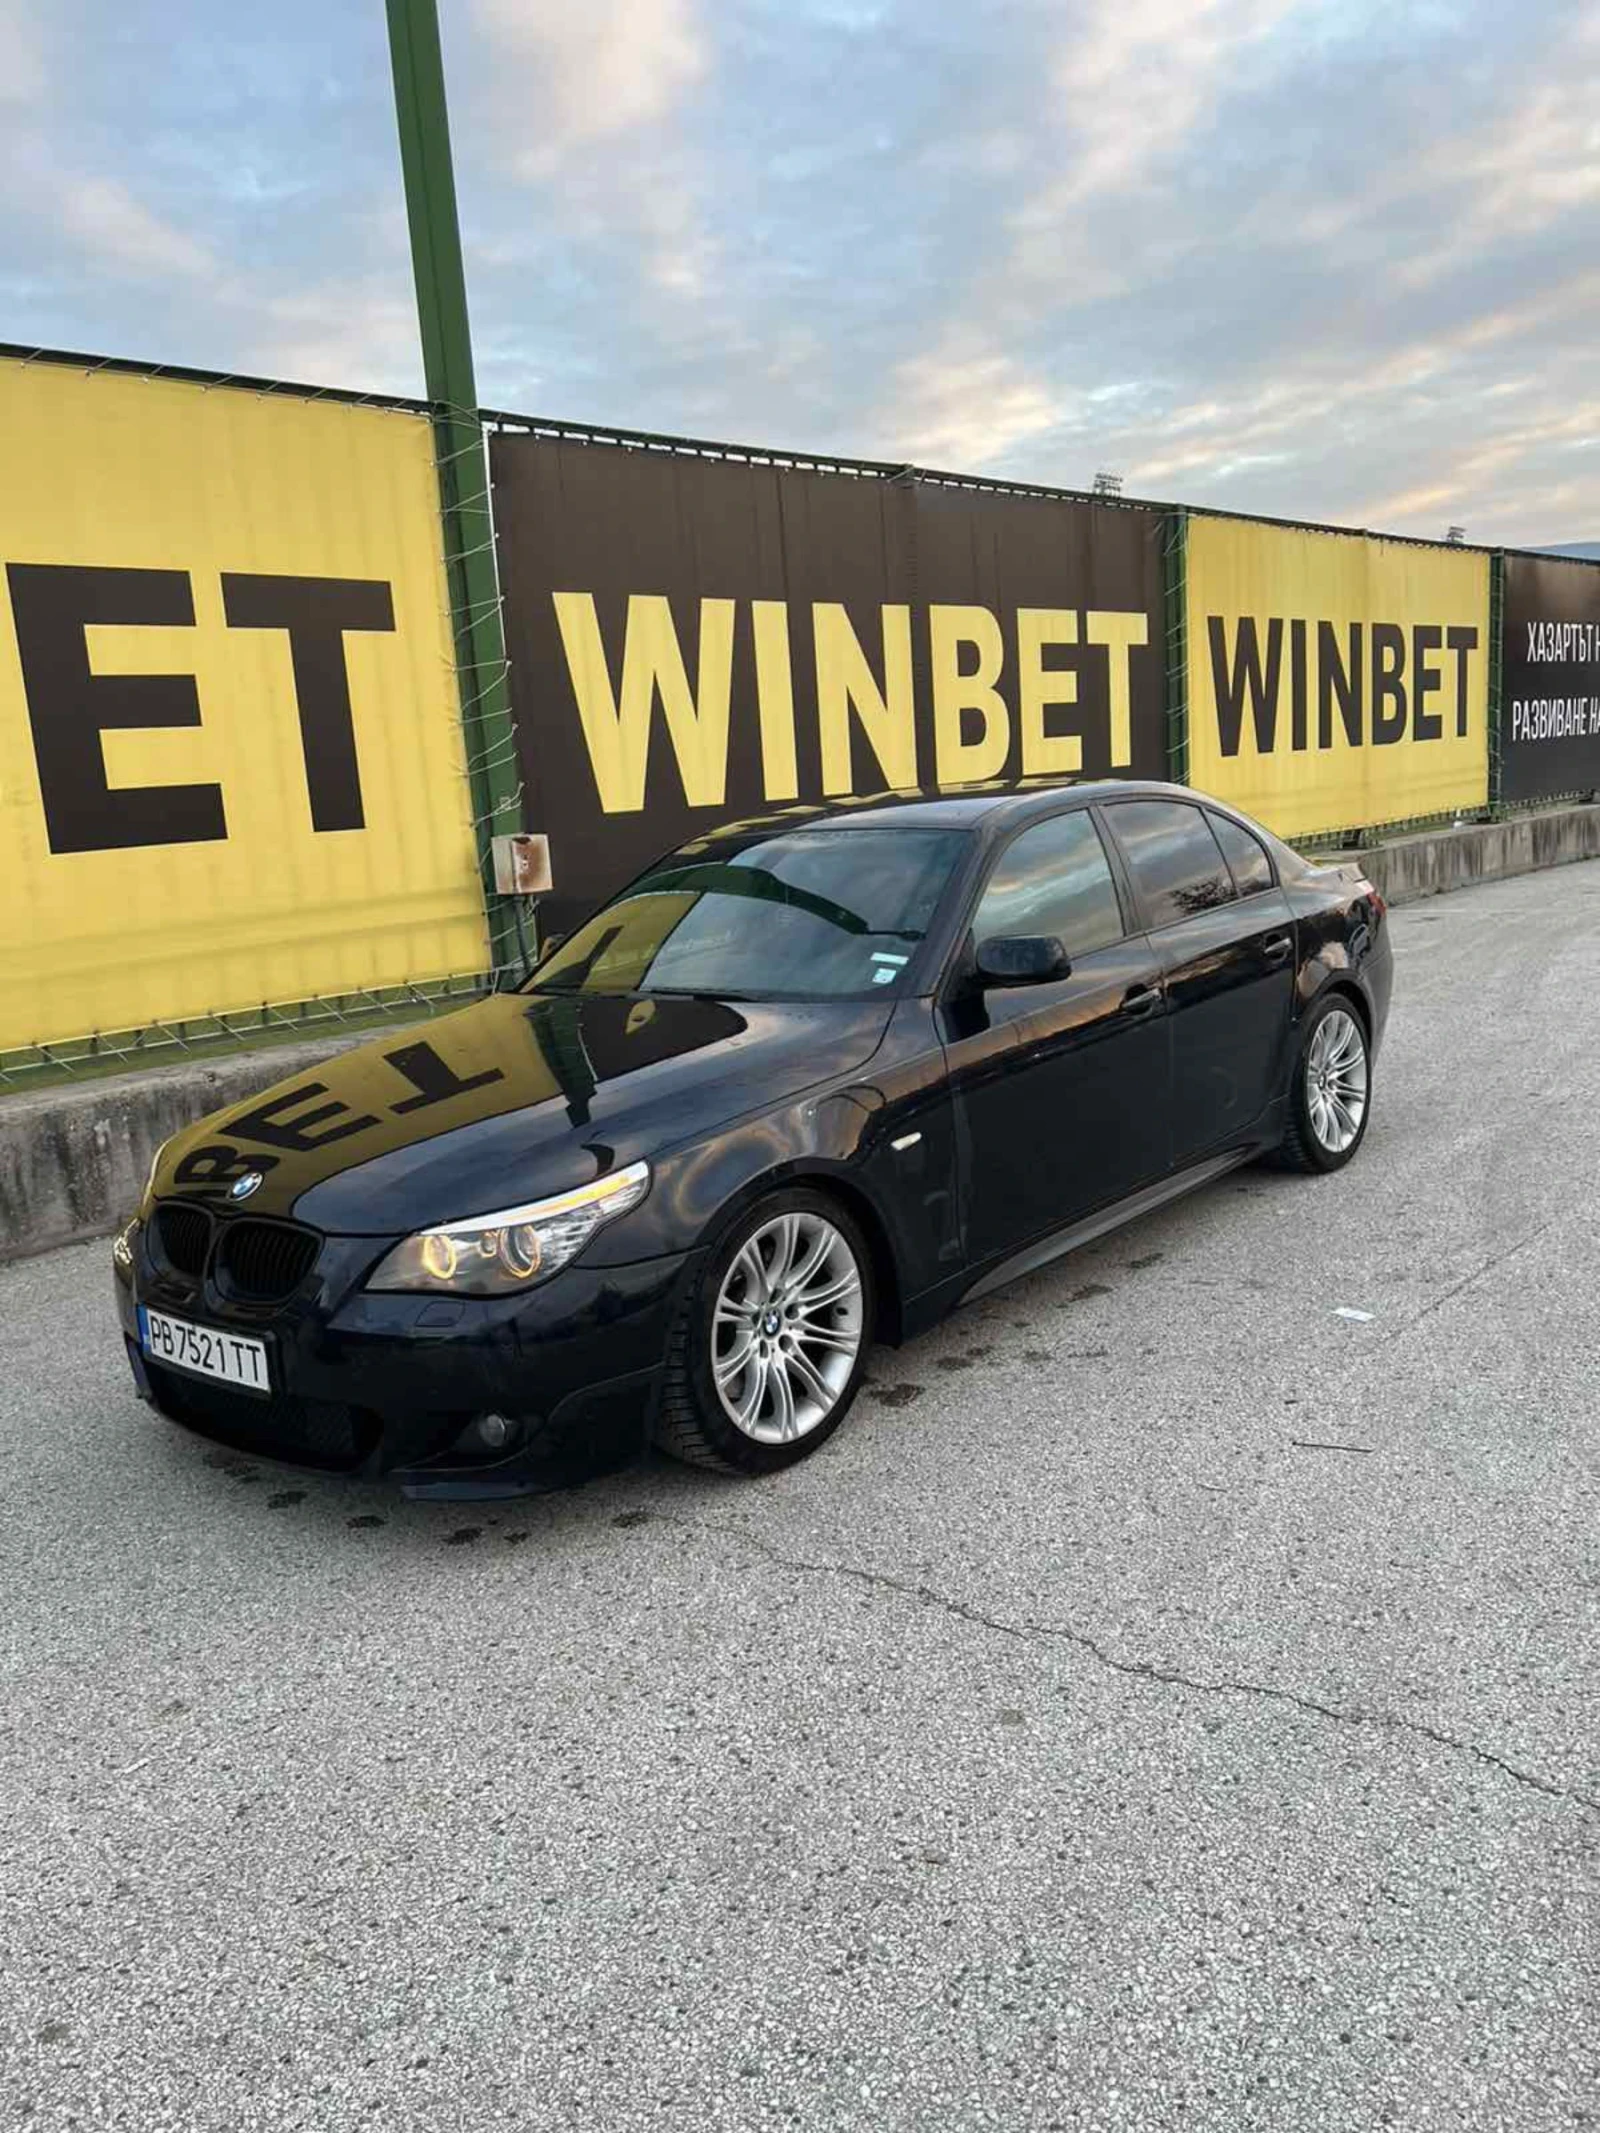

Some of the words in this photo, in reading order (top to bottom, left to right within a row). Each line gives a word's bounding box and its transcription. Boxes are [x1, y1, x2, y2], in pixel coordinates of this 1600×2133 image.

[5, 562, 396, 855] ET
[552, 591, 1148, 814] WINBET
[1207, 615, 1479, 757] WINBET
[1527, 621, 1594, 662] ХАЗАРТЪТ
[1512, 697, 1588, 741] РАЗВИВАНЕ
